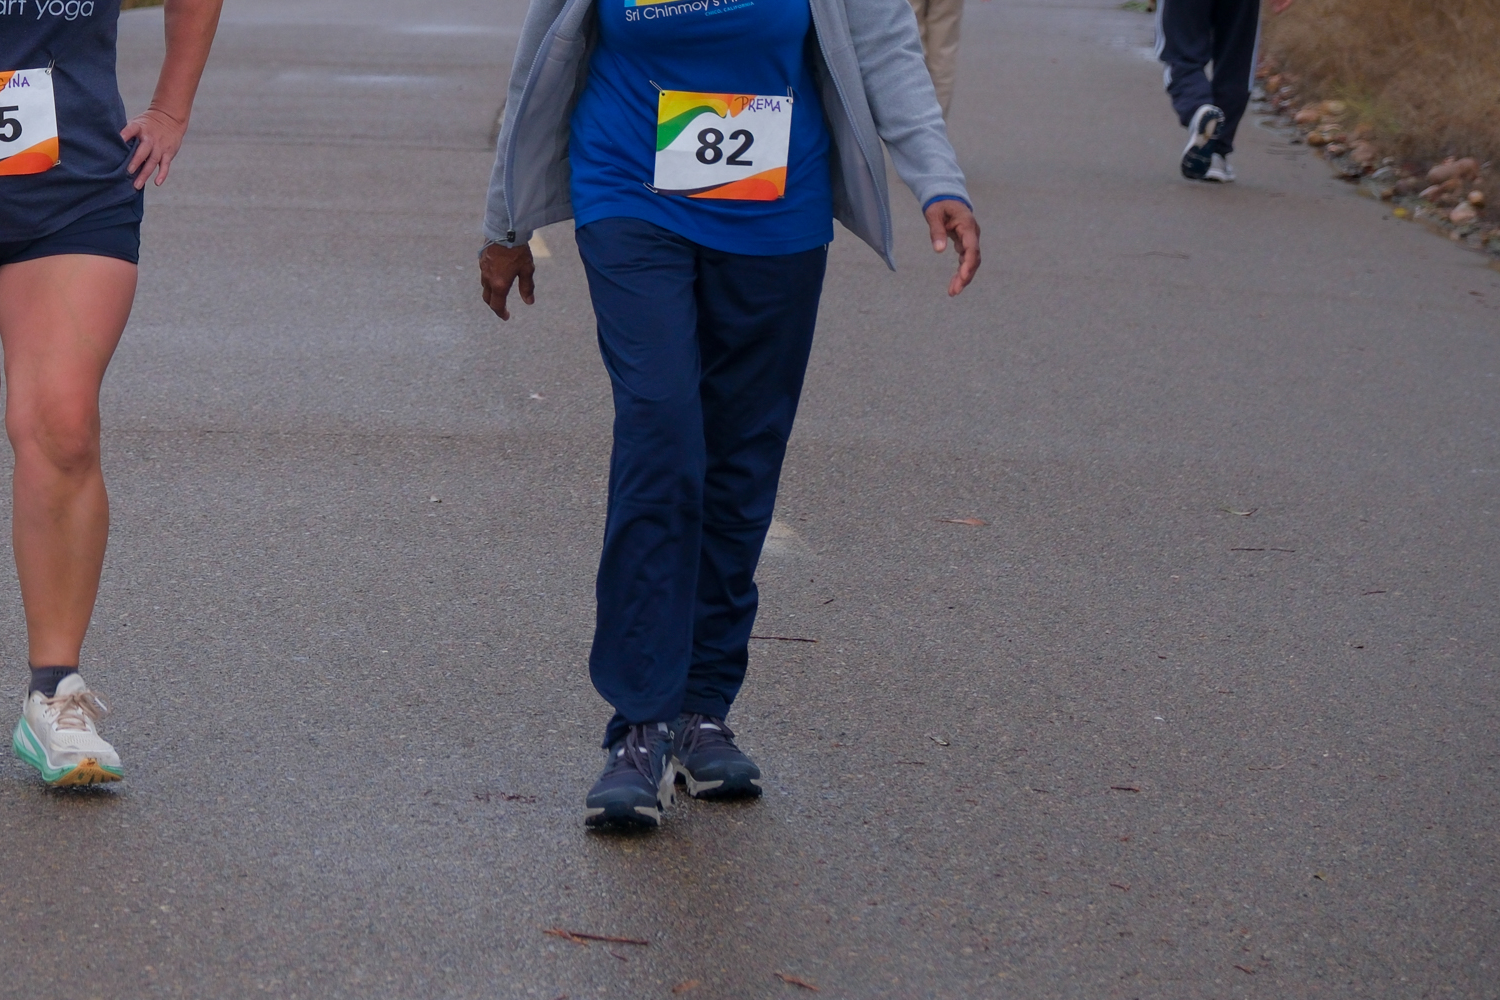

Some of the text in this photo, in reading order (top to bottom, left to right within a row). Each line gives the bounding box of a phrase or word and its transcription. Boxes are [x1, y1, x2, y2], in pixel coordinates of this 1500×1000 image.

[35, 0, 95, 21] yoga
[625, 9, 640, 22] Sri
[705, 1, 755, 16] CHICO, CALIFORNIA
[734, 96, 781, 113] PREMA
[696, 128, 755, 167] 82
